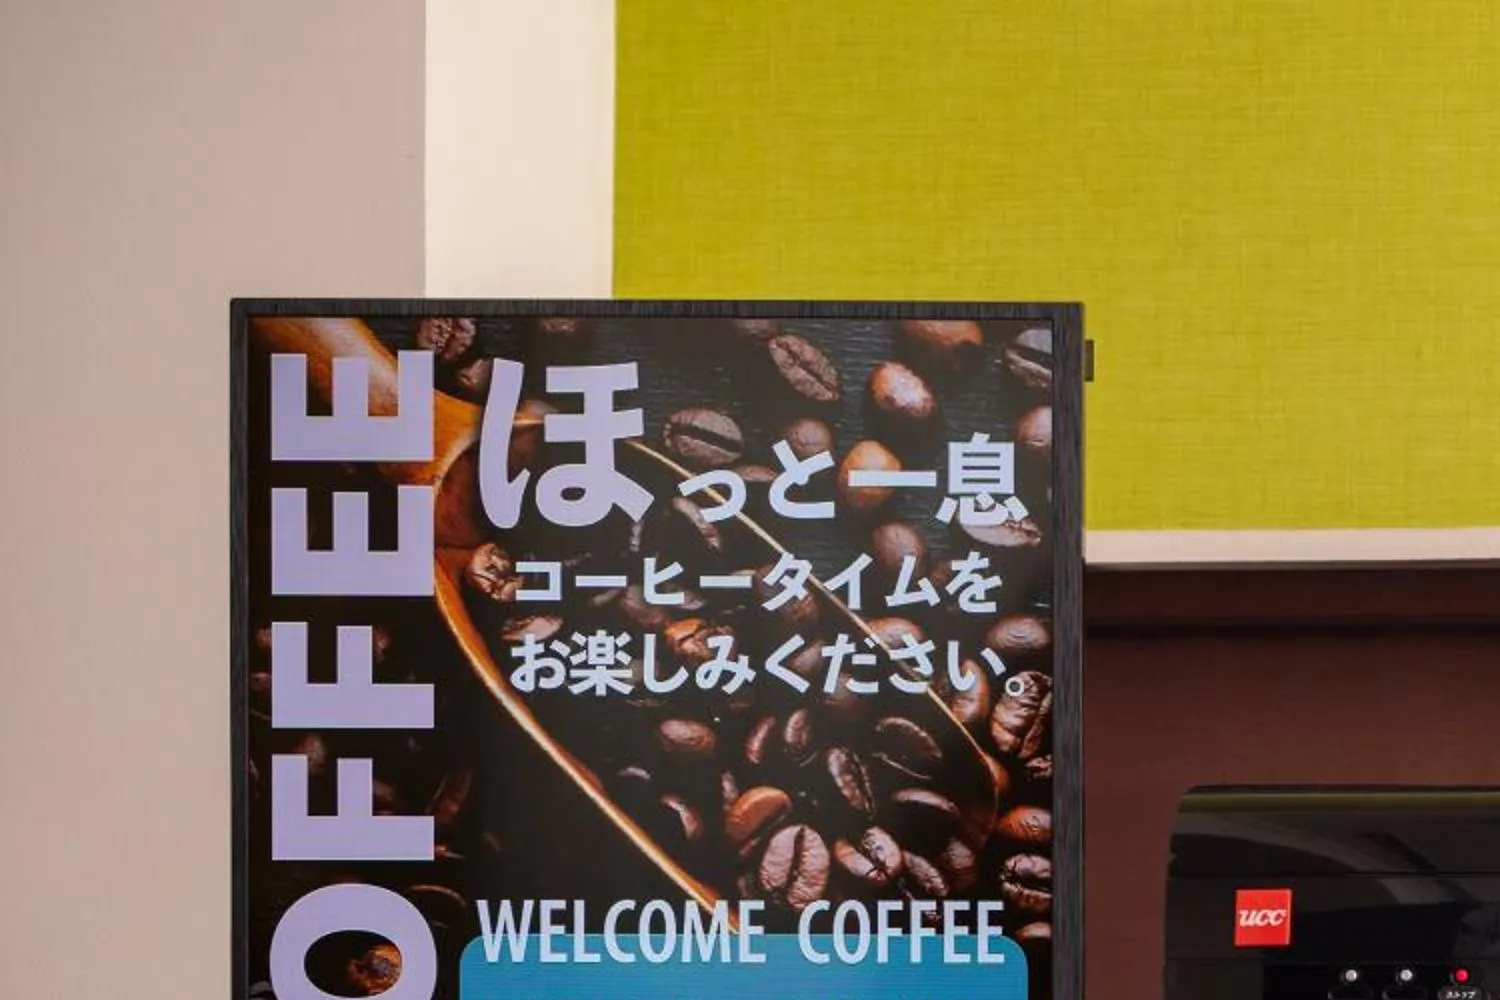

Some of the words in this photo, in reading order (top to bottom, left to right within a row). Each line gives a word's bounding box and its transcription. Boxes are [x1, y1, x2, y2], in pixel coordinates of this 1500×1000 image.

[478, 357, 1027, 530] ほっと一息
[514, 552, 1003, 613] コーヒータイムを
[508, 630, 1026, 698] お楽しみください。
[477, 898, 767, 965] WELCOME
[799, 898, 1006, 965] COFFEE
